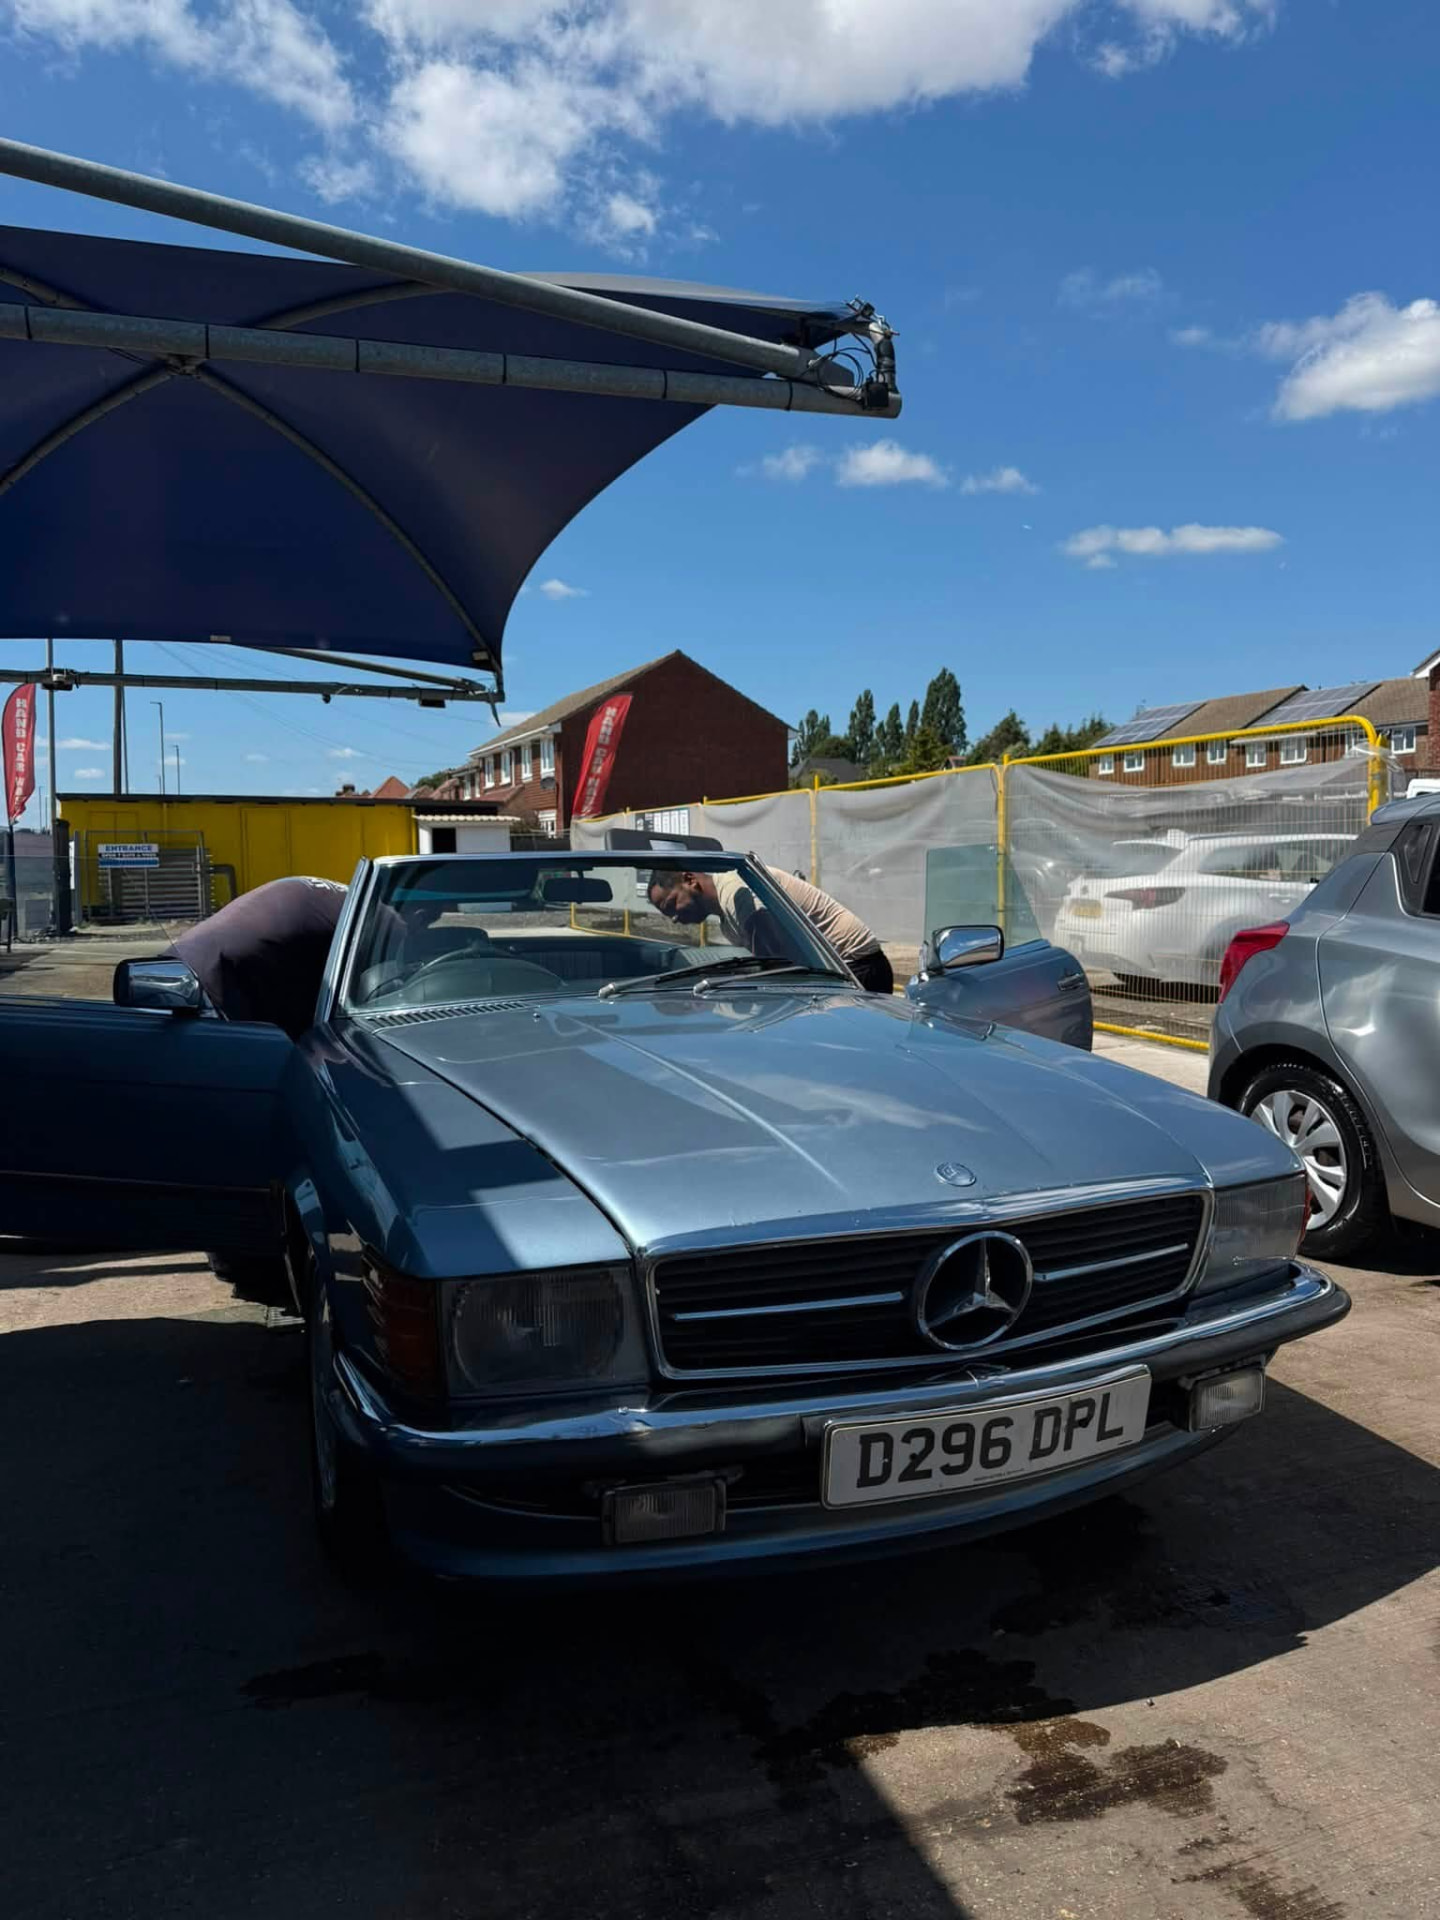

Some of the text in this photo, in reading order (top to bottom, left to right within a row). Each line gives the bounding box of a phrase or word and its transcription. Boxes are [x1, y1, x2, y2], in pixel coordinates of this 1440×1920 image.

[15, 698, 27, 738] HAND
[15, 742, 25, 772] CAR
[857, 1391, 1124, 1488] D296 DPL
